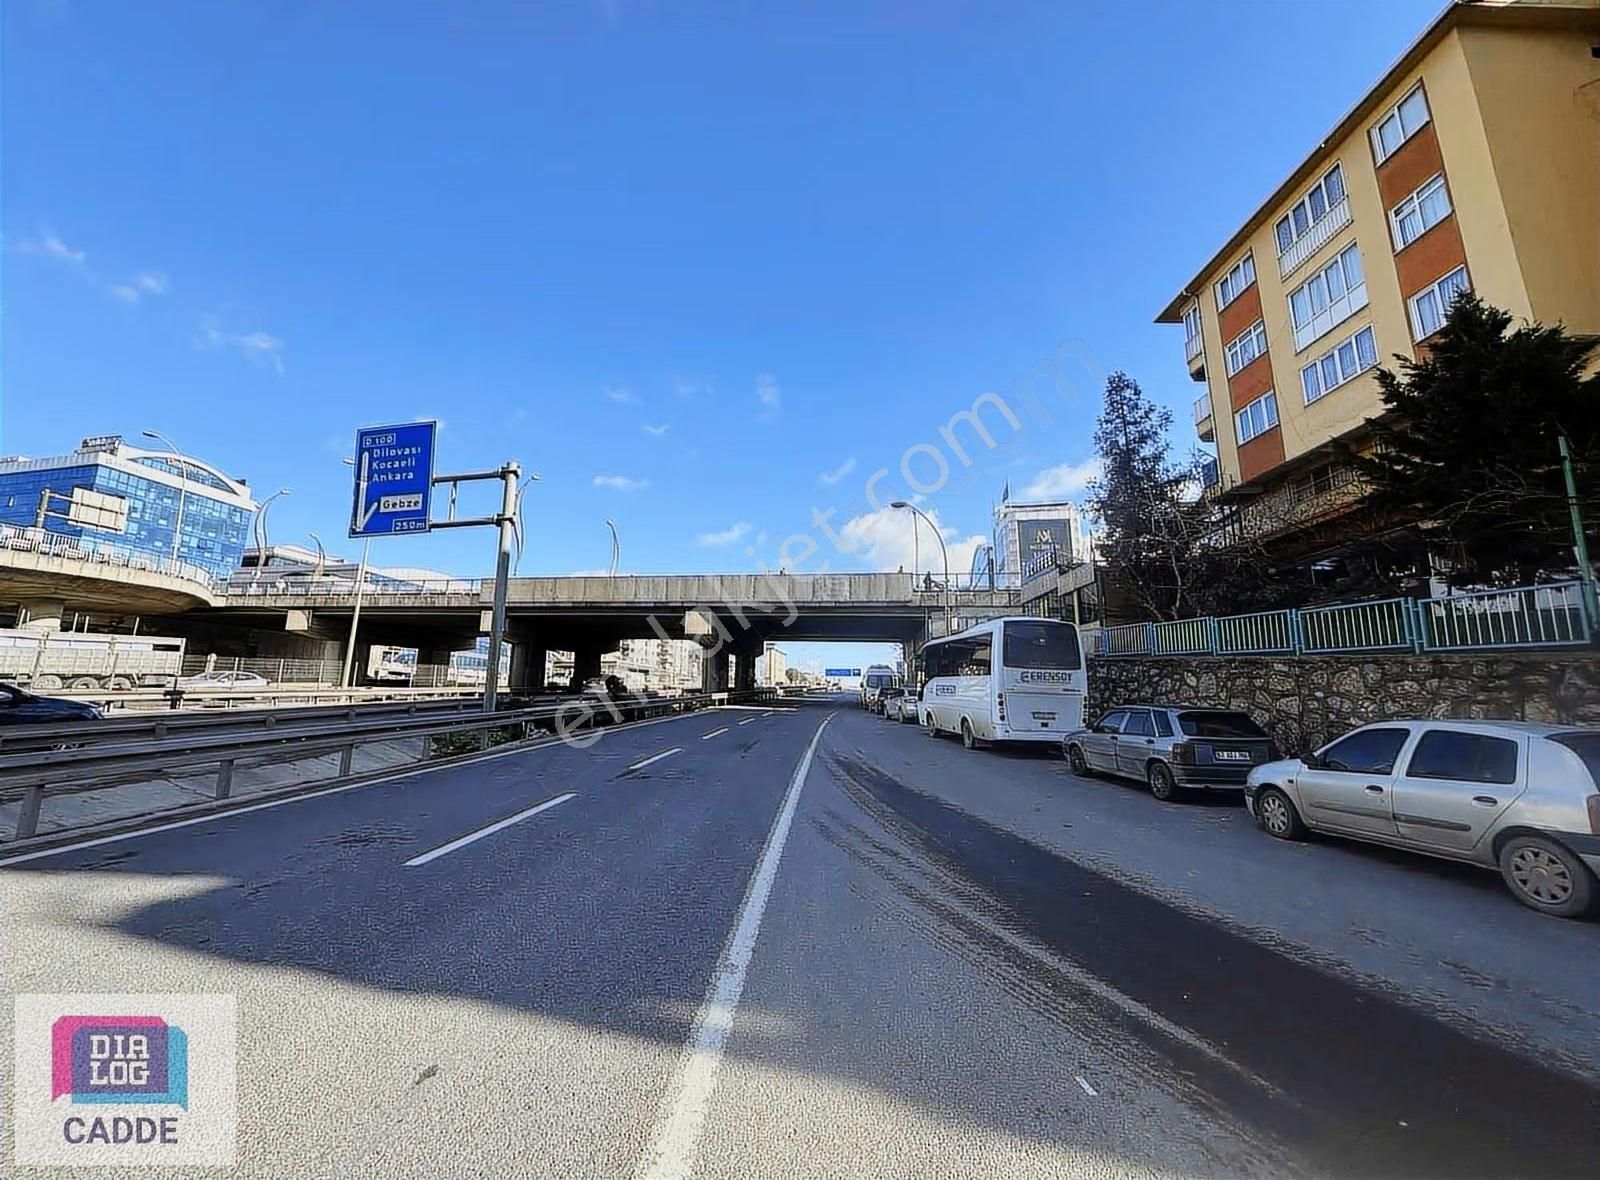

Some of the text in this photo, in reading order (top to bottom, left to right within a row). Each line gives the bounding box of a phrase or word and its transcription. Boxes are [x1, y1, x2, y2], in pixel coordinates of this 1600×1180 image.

[365, 435, 393, 446] D 100
[372, 456, 415, 470] Kocaeli
[372, 471, 414, 483] Ankara
[382, 499, 420, 510] Gebze
